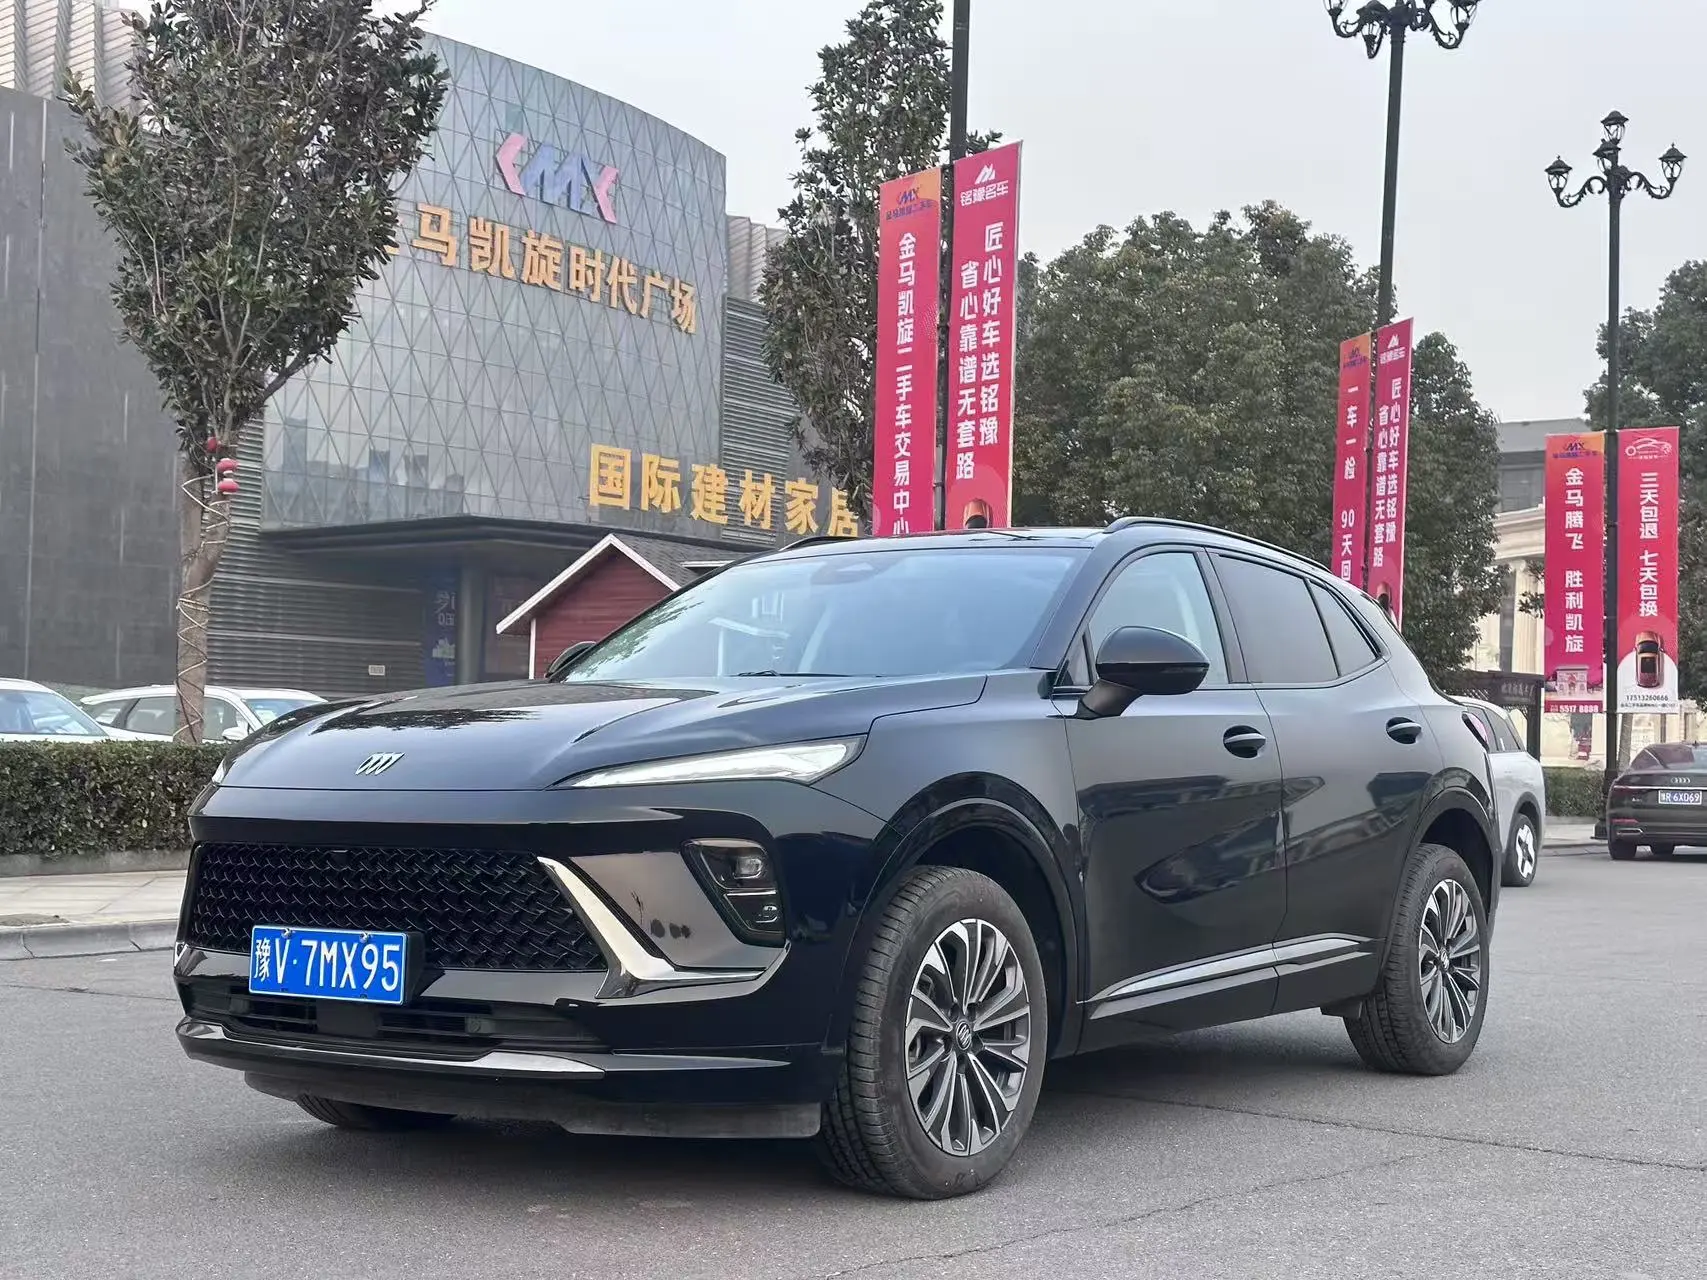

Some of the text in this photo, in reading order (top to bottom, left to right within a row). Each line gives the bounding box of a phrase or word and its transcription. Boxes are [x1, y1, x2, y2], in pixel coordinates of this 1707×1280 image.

[384, 201, 697, 334] 马凯旋时代广场
[955, 260, 980, 480] 省心靠谱无套路
[979, 221, 1005, 446] 匠心好车选铭豫
[893, 232, 917, 536] 金马凯旋二手车交易中心
[589, 443, 860, 538] 国际建材家居
[1565, 467, 1584, 550] 金马腾飞
[1639, 472, 1659, 540] 三天包退
[1565, 570, 1584, 653] 胜利凯旋
[1639, 550, 1659, 617] 七天包换
[254, 937, 401, 992] 豫V·7MX95
